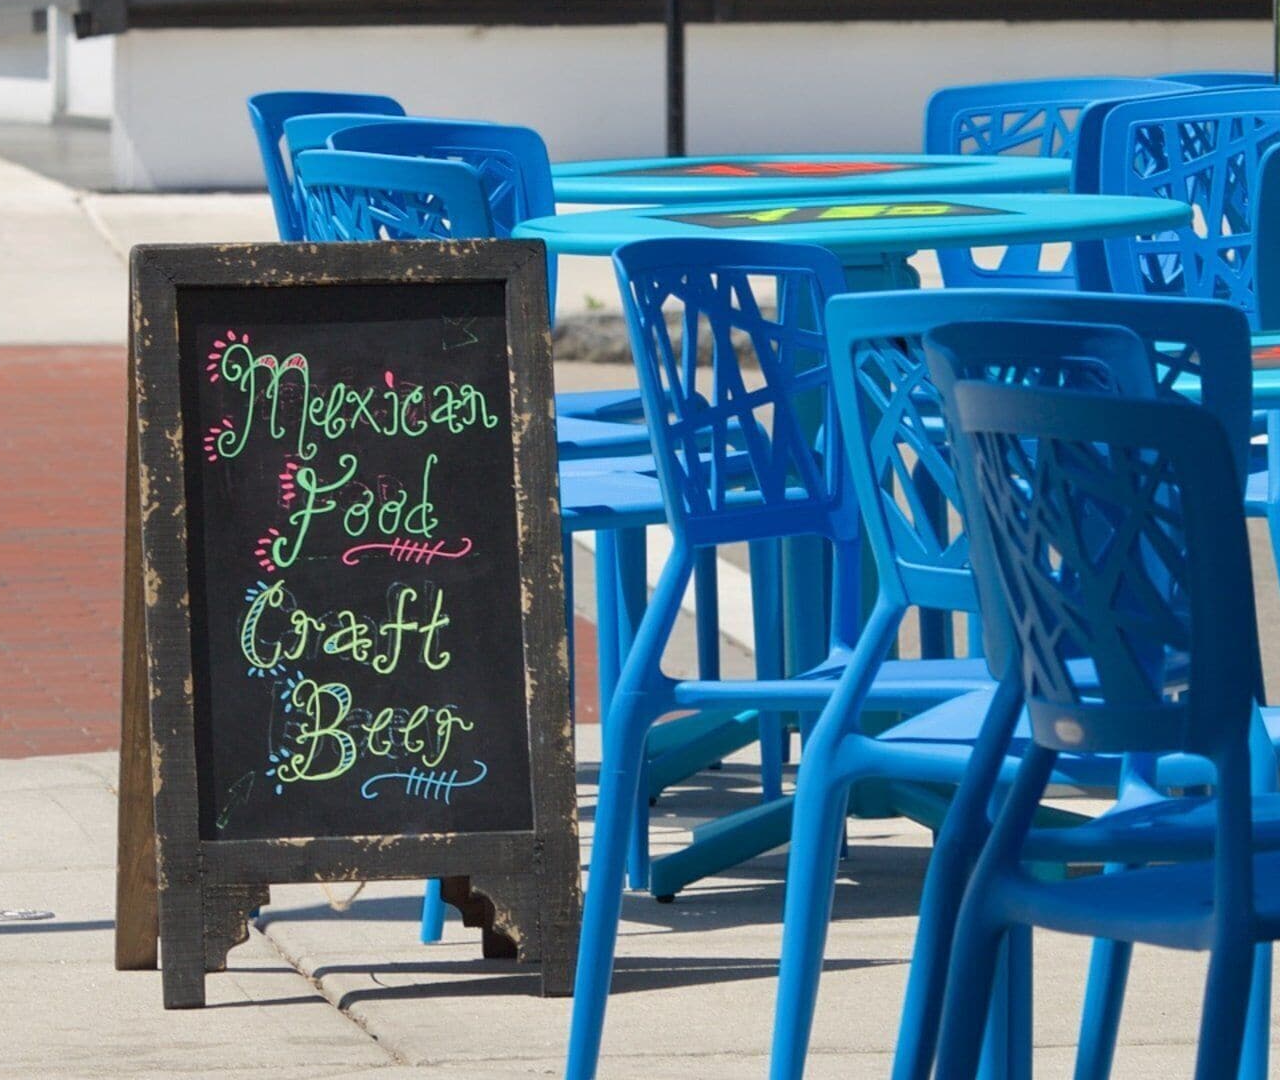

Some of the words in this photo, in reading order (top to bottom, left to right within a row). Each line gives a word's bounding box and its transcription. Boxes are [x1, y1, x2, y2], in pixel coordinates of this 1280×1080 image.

[272, 453, 439, 568] Food
[240, 579, 451, 674] Craft
[277, 678, 475, 782] Beer
